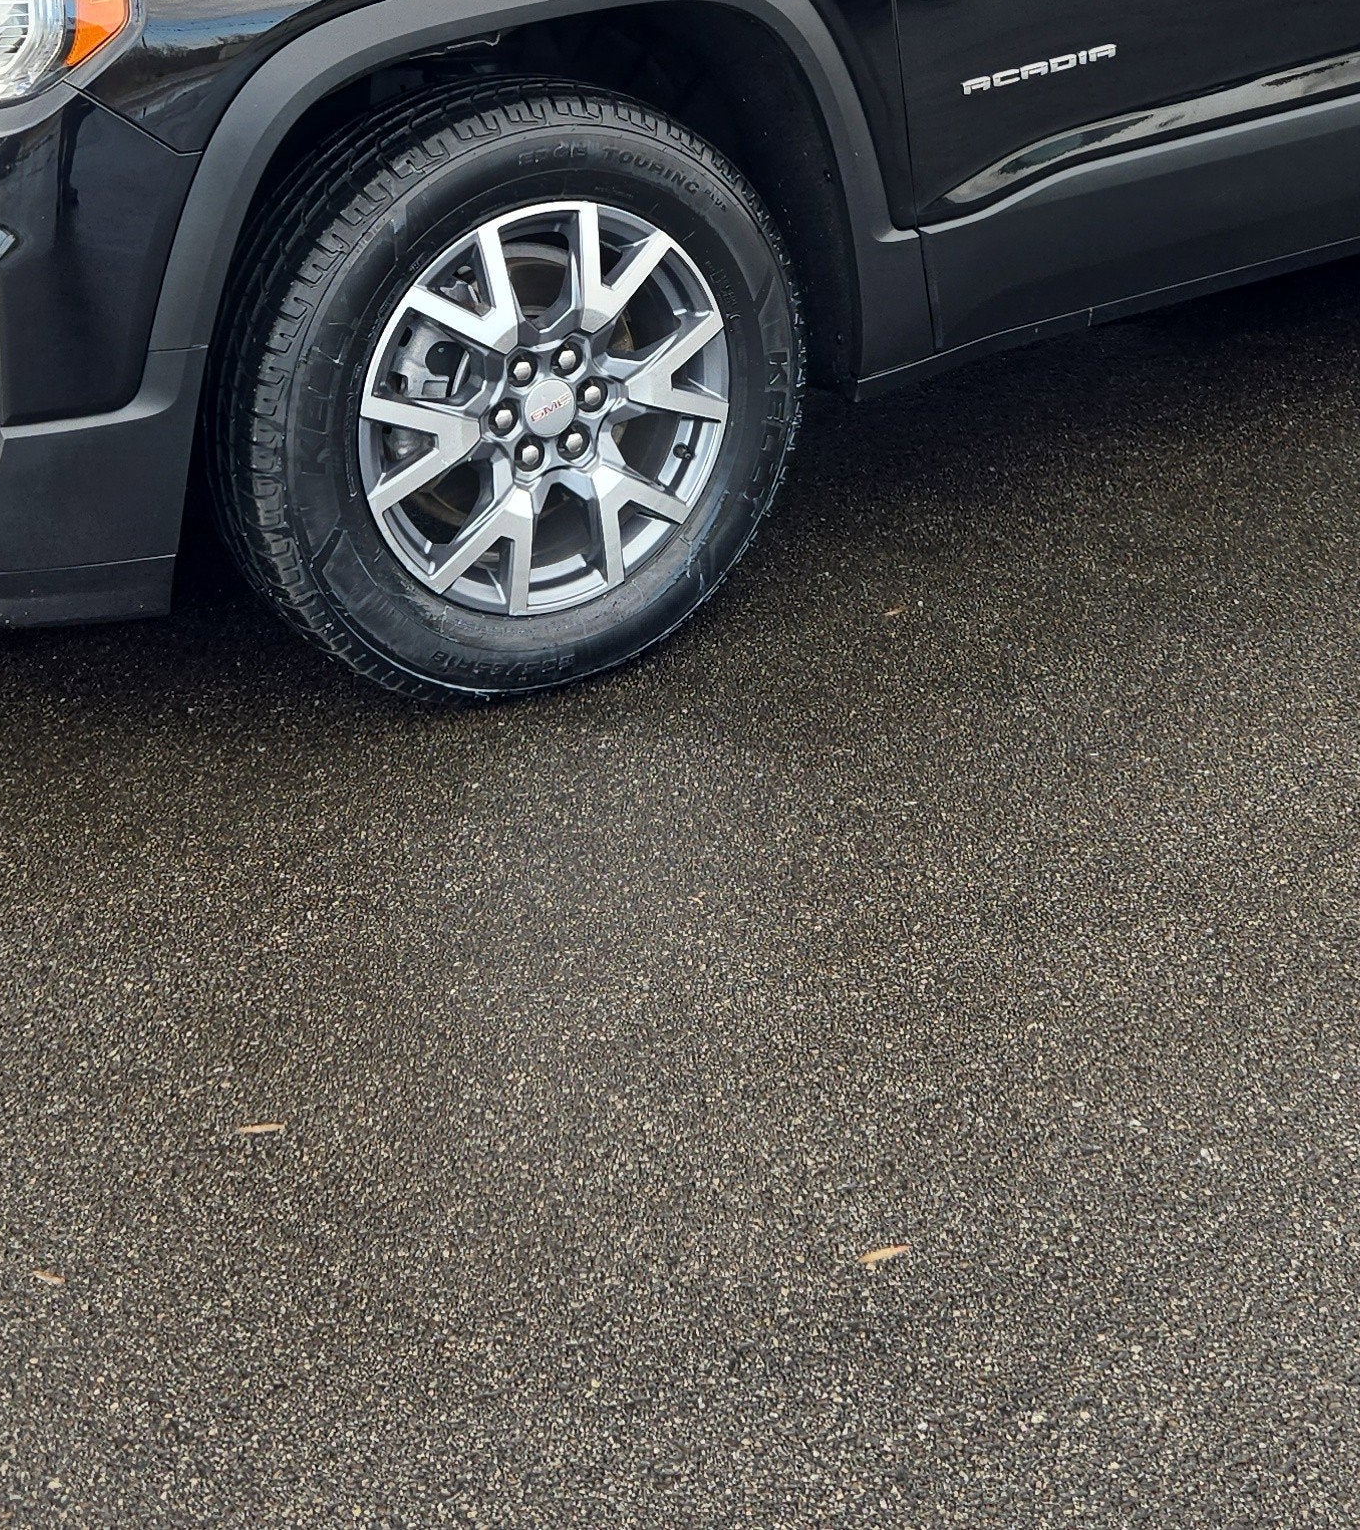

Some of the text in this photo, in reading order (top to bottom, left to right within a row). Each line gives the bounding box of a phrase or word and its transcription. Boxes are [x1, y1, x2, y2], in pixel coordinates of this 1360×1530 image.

[961, 43, 1117, 95] ACADIA
[602, 146, 700, 196] TOURING
[529, 391, 573, 423] GMC
